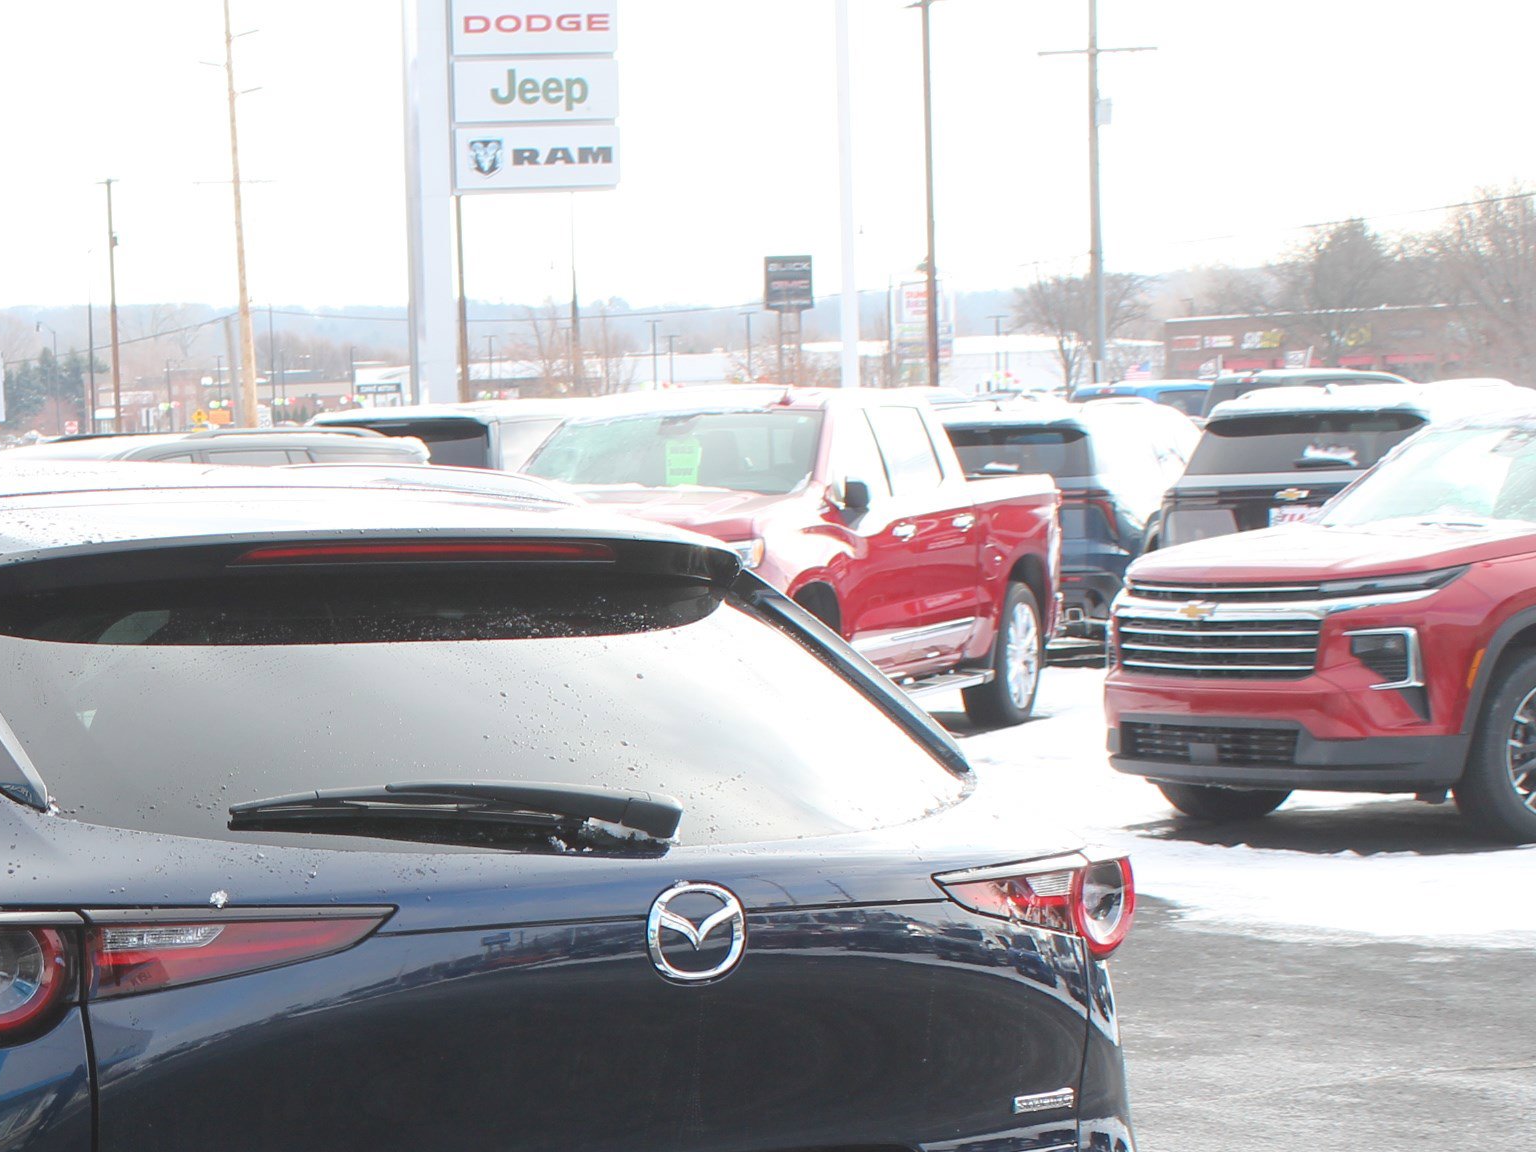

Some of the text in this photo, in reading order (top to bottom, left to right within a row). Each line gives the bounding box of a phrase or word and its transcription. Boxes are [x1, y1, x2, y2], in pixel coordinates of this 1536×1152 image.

[464, 14, 610, 34] DODGE
[490, 68, 589, 112] Jeep
[512, 146, 613, 166] RAM
